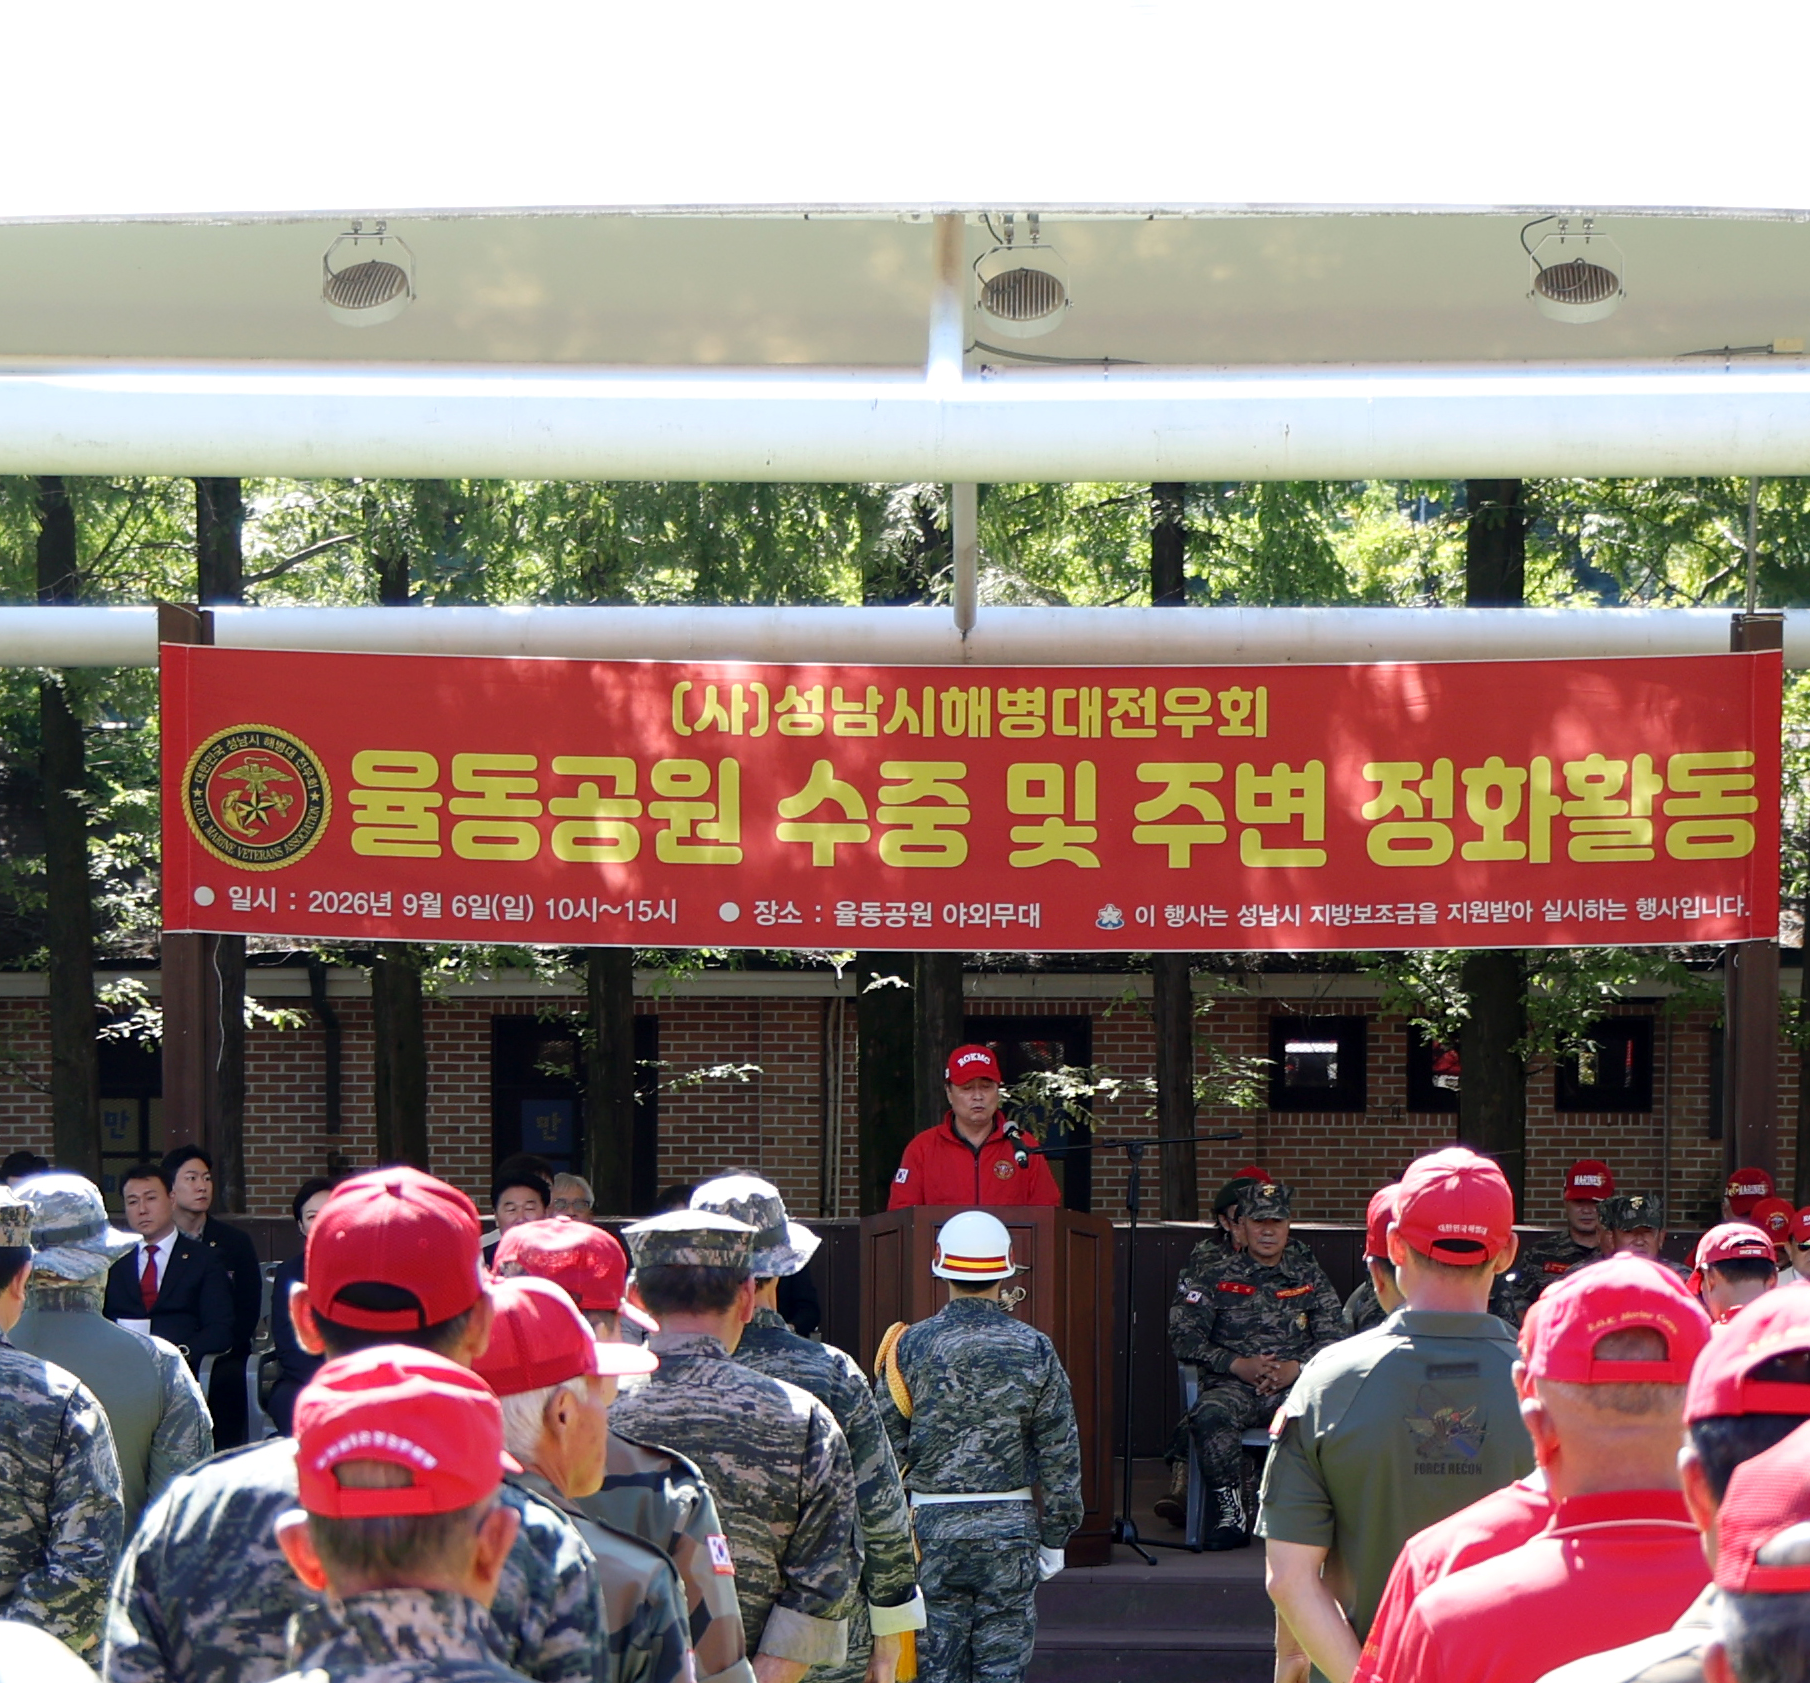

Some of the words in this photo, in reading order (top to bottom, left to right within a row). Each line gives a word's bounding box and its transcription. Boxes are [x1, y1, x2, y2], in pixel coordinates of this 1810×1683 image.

[672, 681, 1268, 737] (사)성남시해병대전우회
[227, 733, 260, 751] 성남시
[263, 736, 297, 758] 해병대
[348, 749, 743, 865] 율동공원
[776, 757, 971, 868] 수중
[1006, 759, 1100, 868] 및
[1132, 757, 1327, 868] 주변
[1362, 751, 1758, 866] 정화활동
[204, 823, 237, 854] MARINE
[237, 846, 284, 861] VETERANS
[284, 805, 321, 854] ASSOCIATION
[228, 886, 276, 912] 일시
[308, 890, 392, 917] 2026년
[402, 891, 441, 918] 9월
[451, 893, 534, 921] 6일(일)
[545, 898, 677, 923] 10시~15시
[753, 899, 803, 925] 장소
[833, 900, 932, 925] 율동공원
[942, 902, 1040, 928] 야외무대
[1135, 904, 1155, 927] 이
[1163, 904, 1228, 927] 행사는
[1236, 903, 1301, 927] 성남시
[1309, 902, 1438, 926] 지방보조금을
[1447, 900, 1533, 923] 지원받아
[1541, 898, 1627, 922] 실시하는
[1635, 895, 1750, 921] 행사입니다.
[957, 1052, 991, 1067] ROKMC
[1574, 1174, 1602, 1187] MARINES
[1414, 1461, 1446, 1476] FORCE
